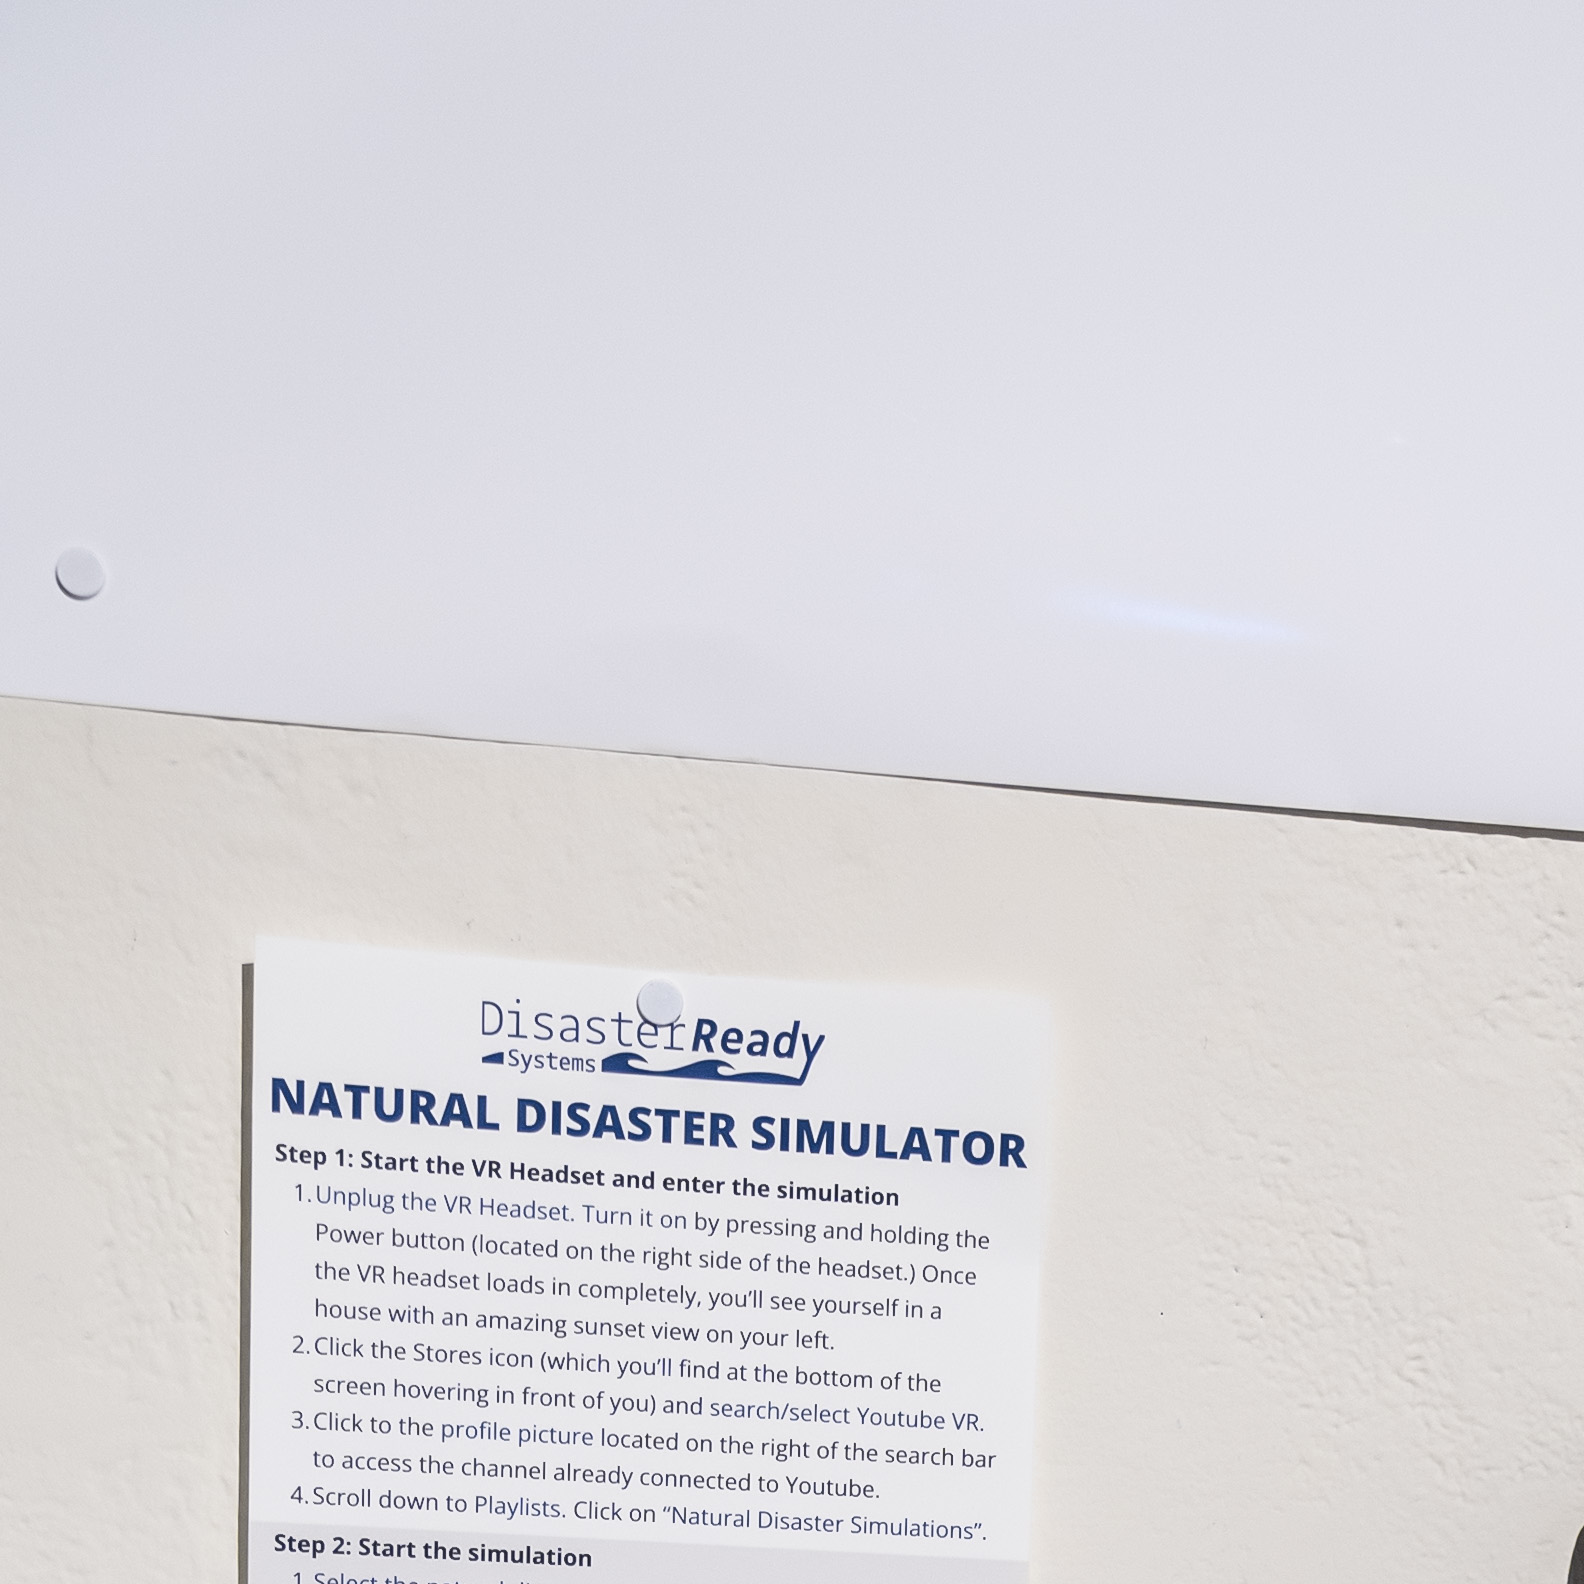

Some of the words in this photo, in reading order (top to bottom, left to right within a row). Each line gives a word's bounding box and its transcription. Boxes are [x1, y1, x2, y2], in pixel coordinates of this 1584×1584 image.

[507, 1048, 597, 1075] Systems
[272, 1077, 500, 1131] NATURAL
[517, 1098, 738, 1148] DISASTER
[752, 1116, 1028, 1169] SIMULATOR
[275, 1144, 327, 1170] Step
[335, 1149, 353, 1167] 1:
[361, 1150, 418, 1173] Start
[426, 1155, 464, 1176] the
[471, 1159, 502, 1179] VR
[510, 1162, 605, 1186] Headset
[612, 1171, 654, 1189] and
[663, 1177, 725, 1194] enter
[732, 1177, 770, 1198] the
[777, 1181, 898, 1206] simulation
[316, 1298, 381, 1321] house
[388, 1305, 434, 1325] with
[442, 1312, 467, 1327] an
[476, 1313, 567, 1338] amazing
[574, 1320, 645, 1338] sunset
[651, 1322, 700, 1341] view
[707, 1329, 732, 1343] on
[740, 1331, 789, 1350] your
[796, 1329, 834, 1350] left.
[314, 1379, 385, 1396] screen
[394, 1379, 489, 1408] hovering
[497, 1385, 514, 1404] in
[522, 1386, 575, 1408] front
[583, 1391, 605, 1409] of
[610, 1395, 656, 1416] you)
[663, 1397, 702, 1415] and
[710, 1401, 850, 1424] search/select
[857, 1407, 945, 1429] Youtube
[952, 1413, 983, 1431] VR.
[313, 1451, 334, 1468] to
[342, 1455, 412, 1472] access
[419, 1455, 454, 1475] the
[462, 1458, 546, 1480] channel
[554, 1463, 633, 1490] already
[640, 1472, 750, 1491] connected
[758, 1476, 778, 1493] to
[786, 1476, 879, 1498] Youtube.
[275, 1534, 325, 1559] Step
[332, 1537, 351, 1555] 2:
[359, 1538, 416, 1558] Start
[423, 1541, 461, 1560] the
[468, 1544, 591, 1567] simulation
